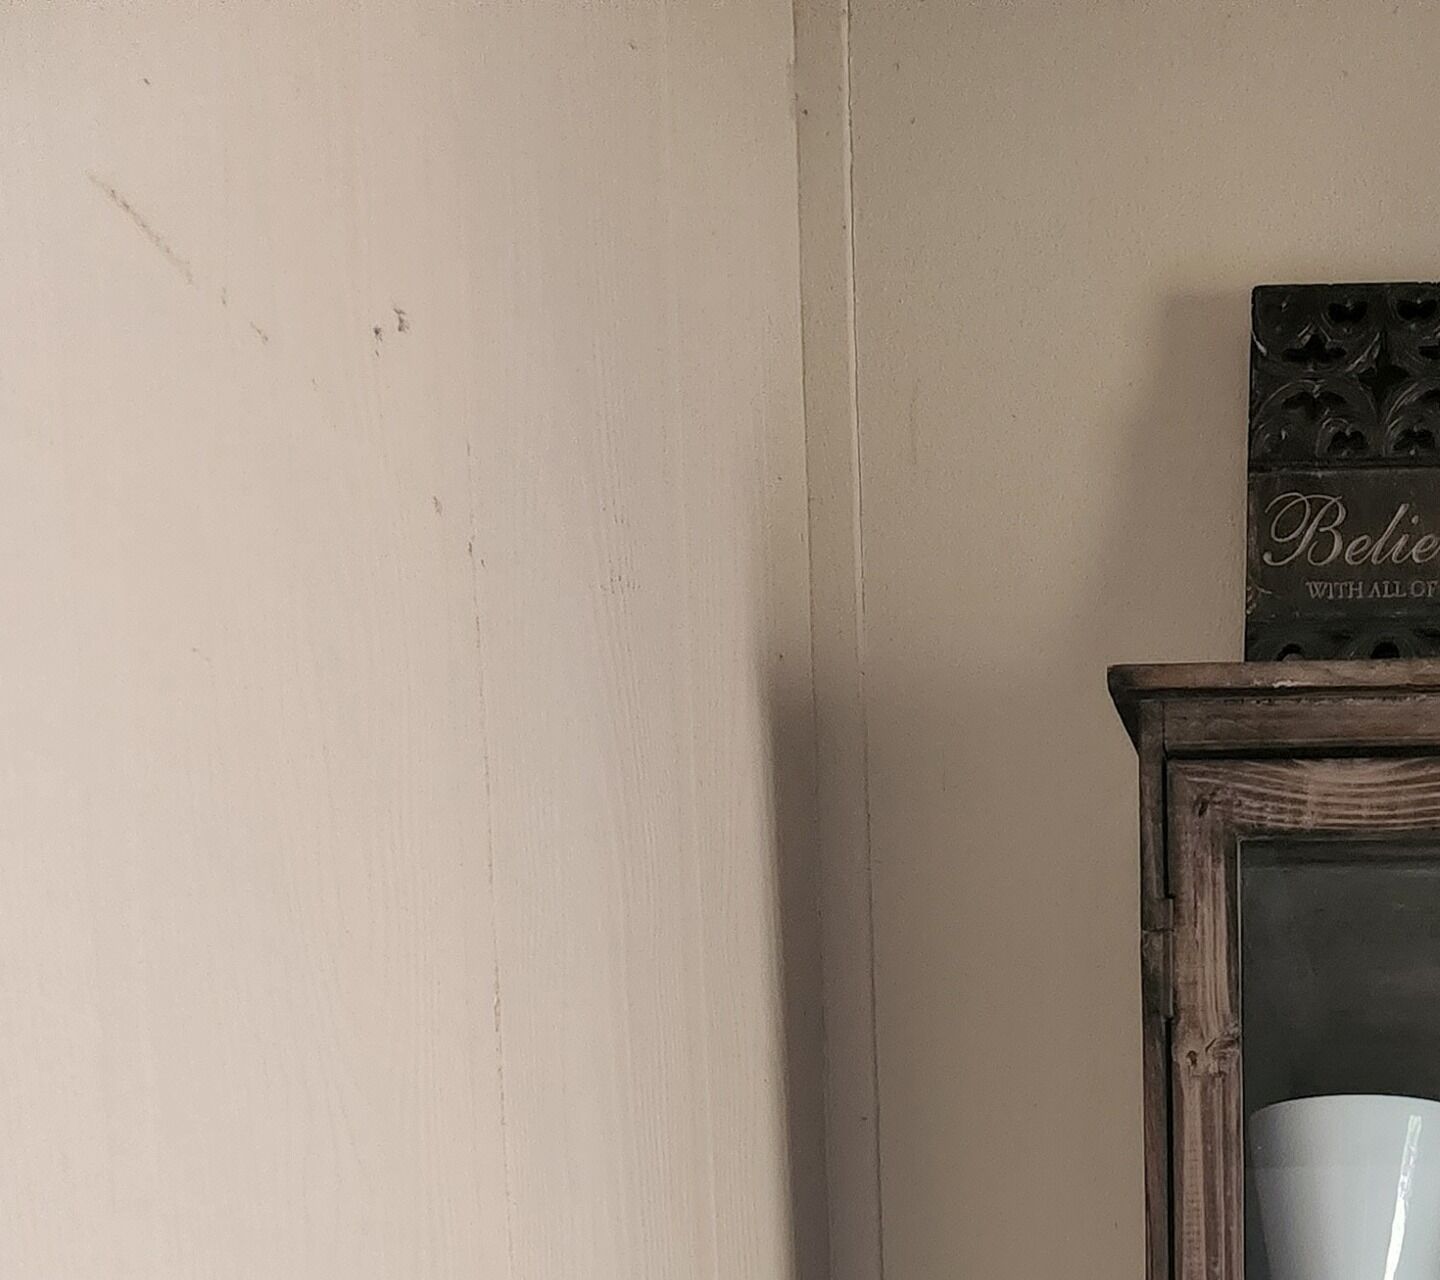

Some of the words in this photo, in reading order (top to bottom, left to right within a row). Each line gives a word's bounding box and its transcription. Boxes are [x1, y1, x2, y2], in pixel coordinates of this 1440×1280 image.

[1305, 580, 1364, 599] WITH
[1369, 580, 1407, 599] ALL
[1410, 580, 1438, 598] OF
